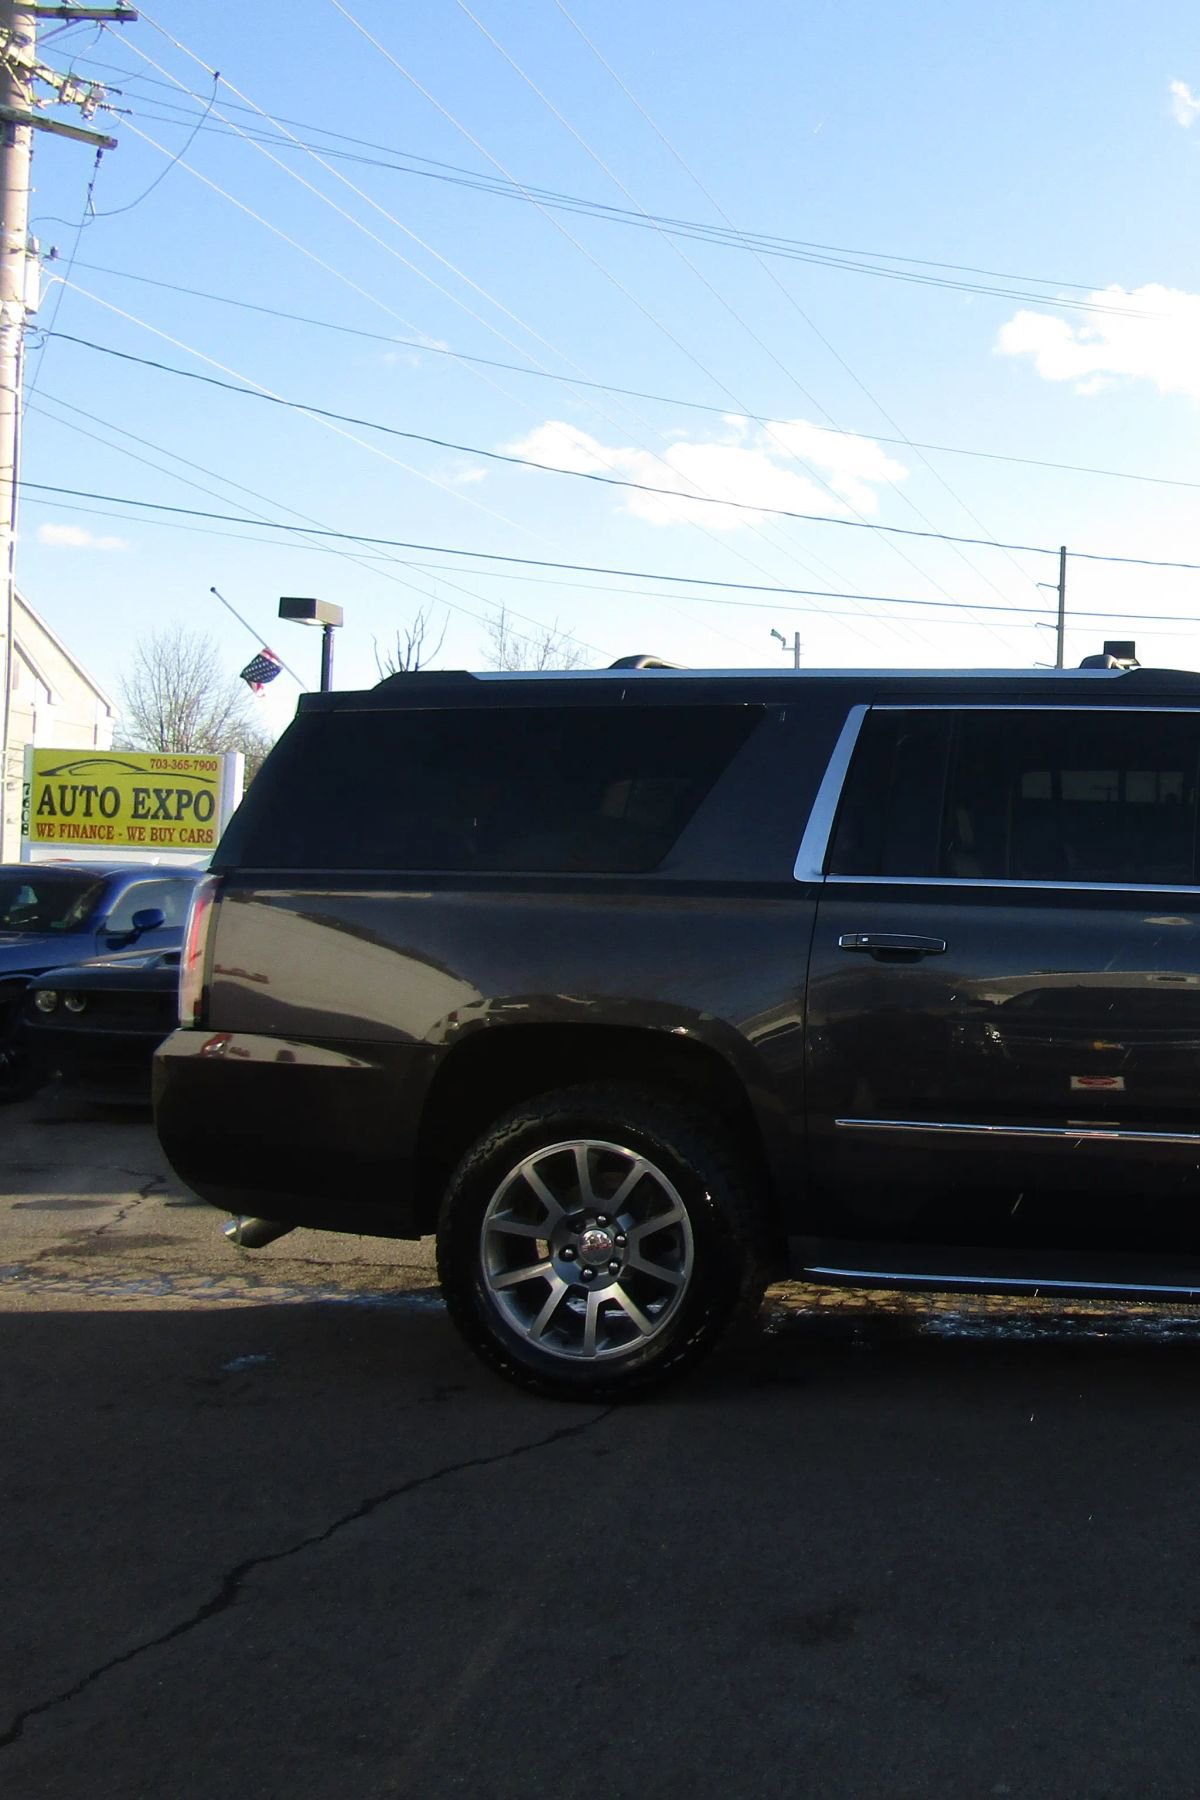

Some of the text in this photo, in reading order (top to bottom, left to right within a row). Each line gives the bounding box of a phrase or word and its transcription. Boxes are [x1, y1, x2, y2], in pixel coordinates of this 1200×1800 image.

[150, 758, 218, 771] 703-365-7900
[36, 783, 216, 822] AUTO EXPO
[36, 822, 56, 838] WE
[59, 823, 115, 840] FINANCE
[127, 826, 146, 841] WE
[150, 826, 176, 842] BUY
[179, 828, 214, 844] CARS
